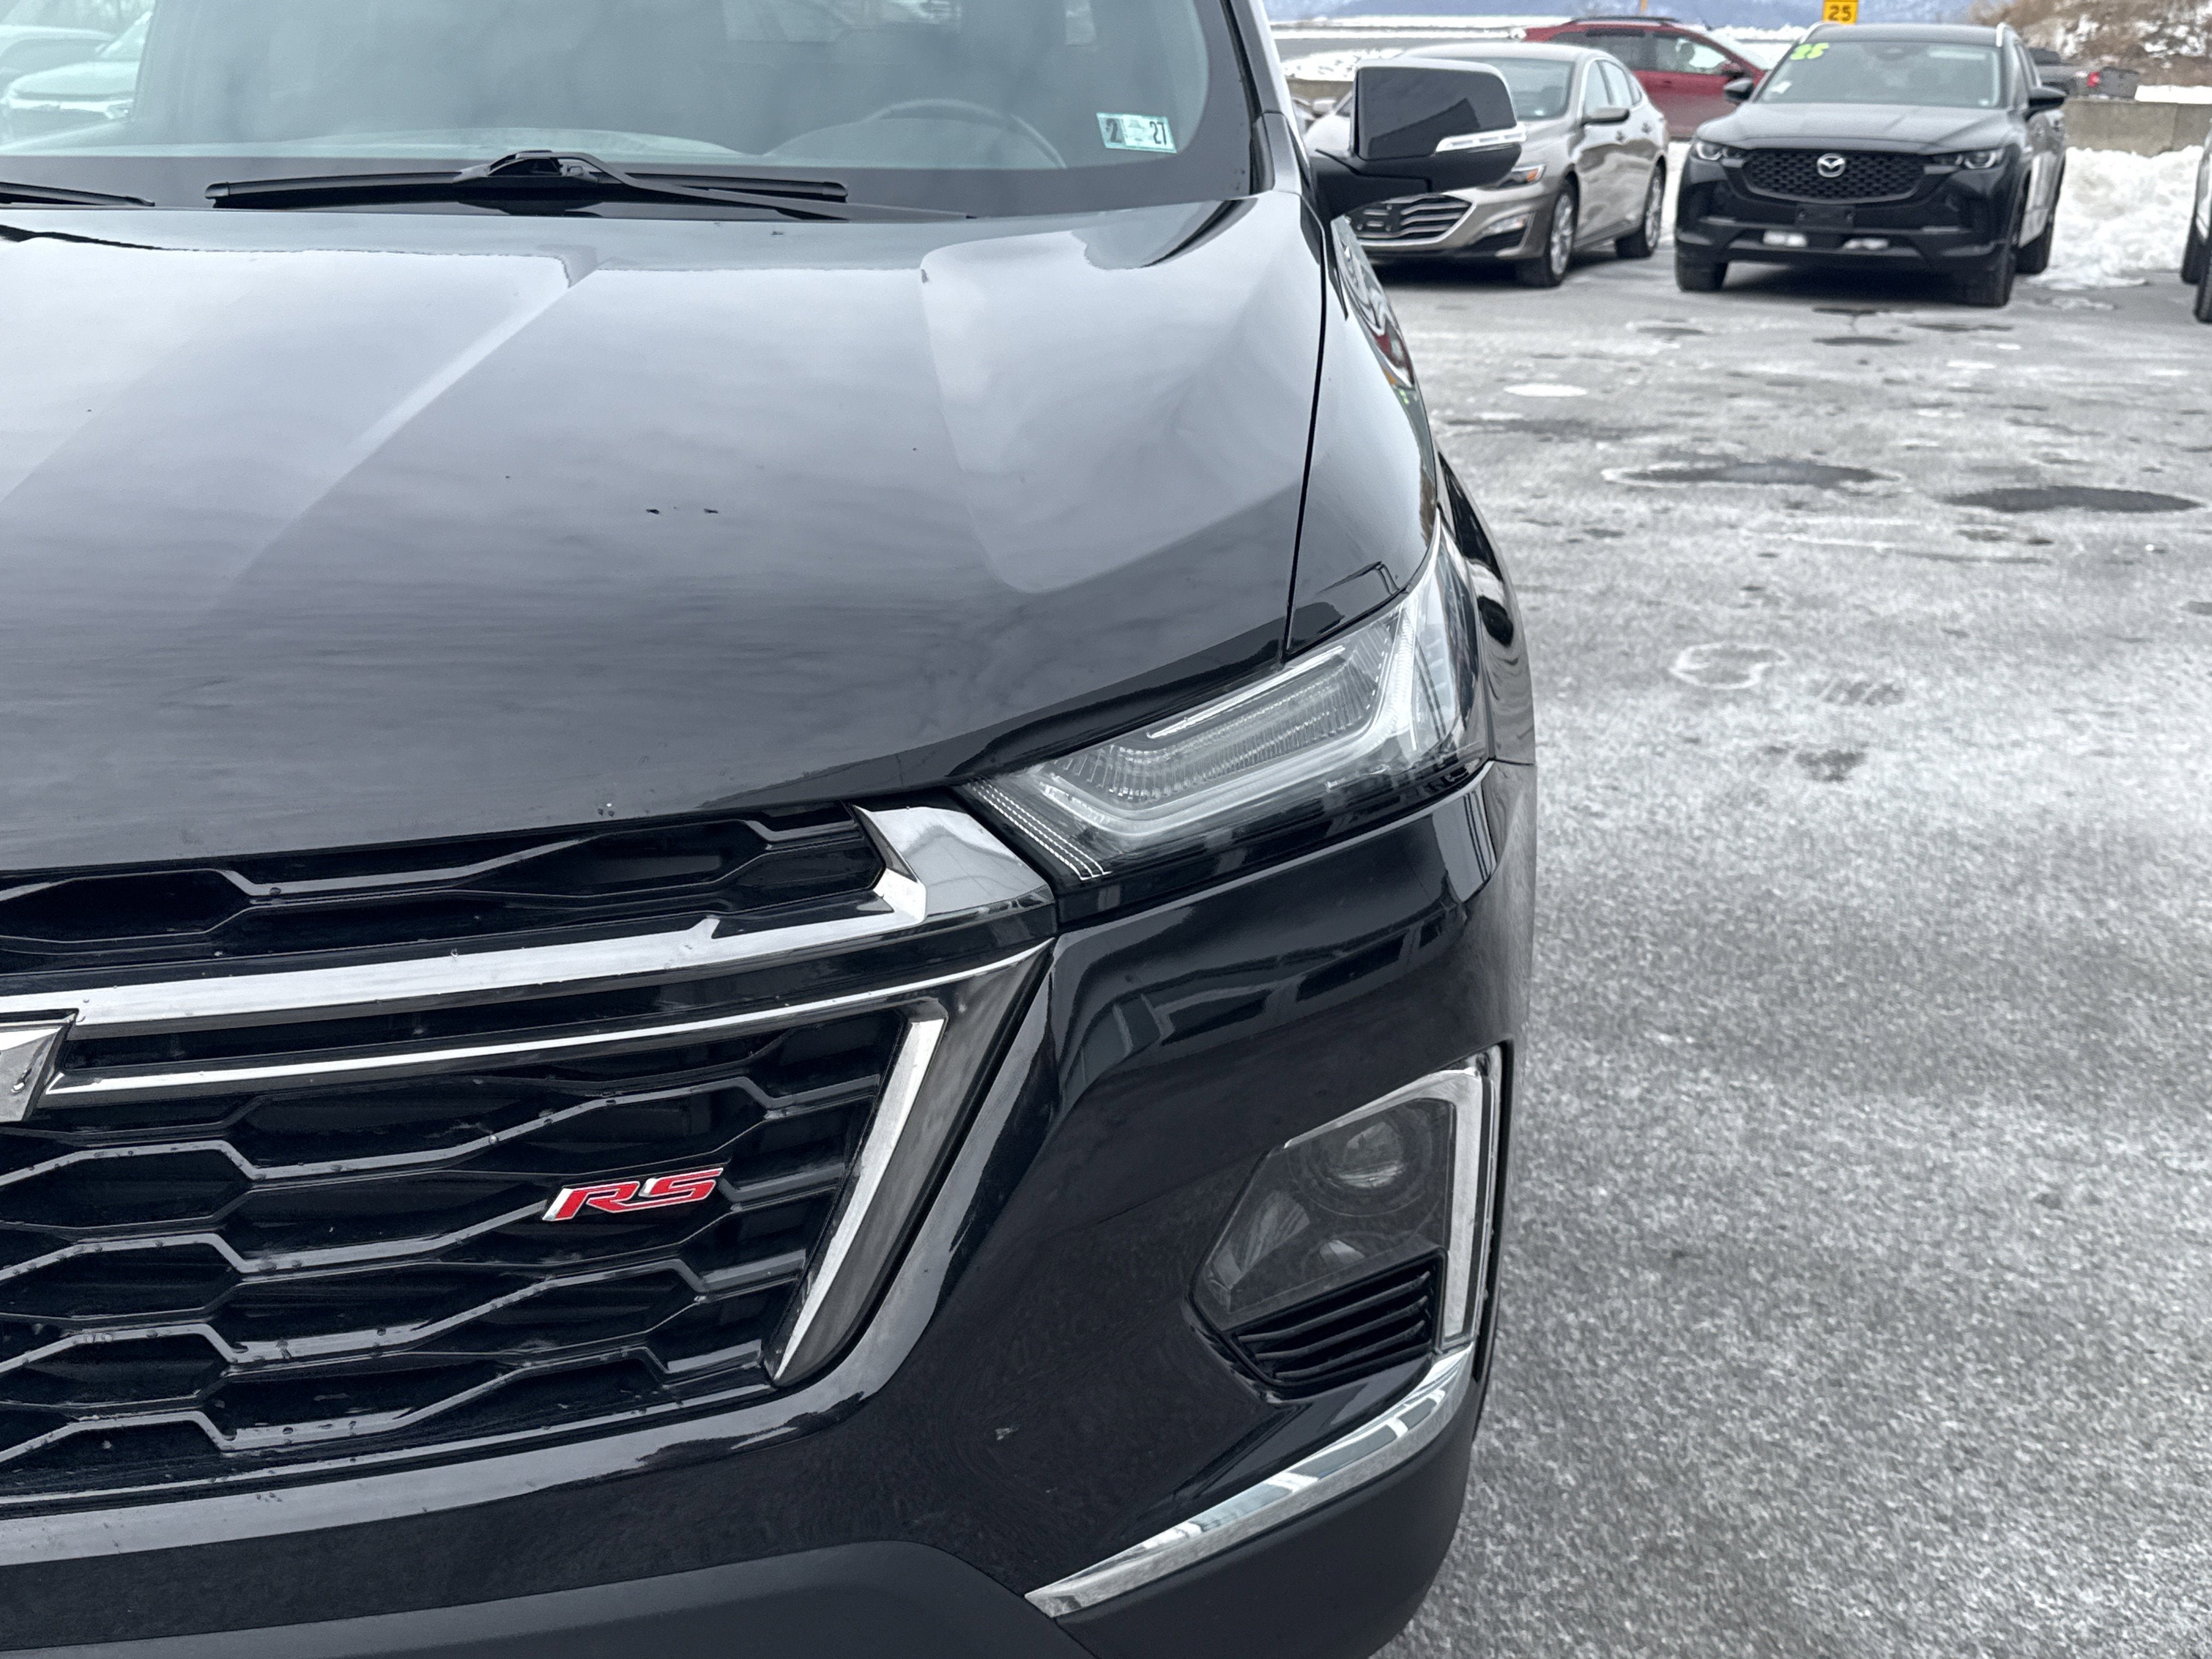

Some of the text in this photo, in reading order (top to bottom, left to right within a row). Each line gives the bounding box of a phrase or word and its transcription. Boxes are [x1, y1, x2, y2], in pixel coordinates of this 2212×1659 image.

[1828, 4, 1851, 21] 25
[1105, 118, 1167, 145] 2 27
[542, 1167, 724, 1221] RS
